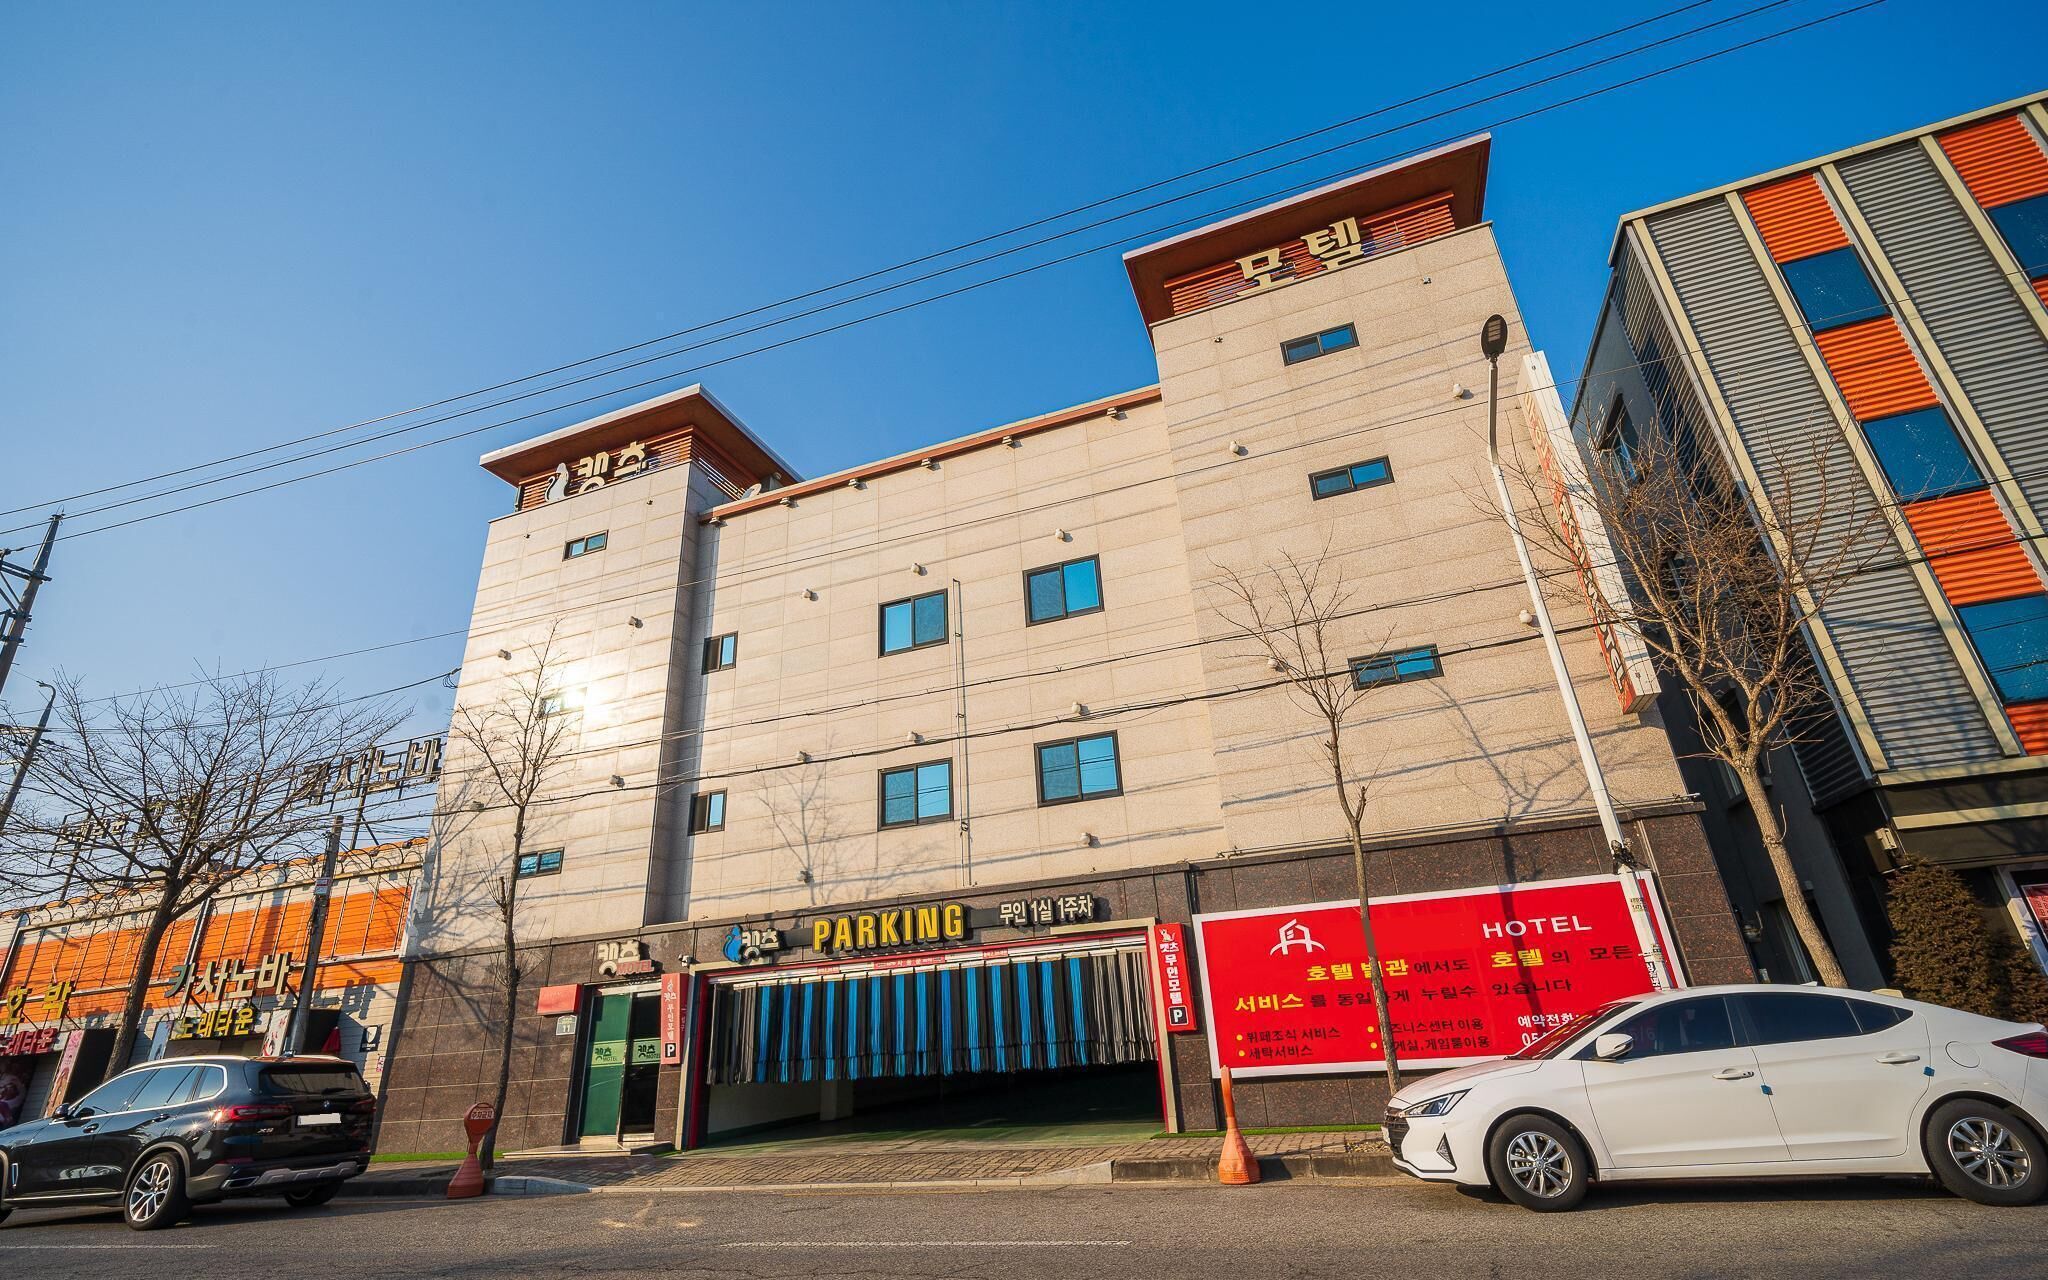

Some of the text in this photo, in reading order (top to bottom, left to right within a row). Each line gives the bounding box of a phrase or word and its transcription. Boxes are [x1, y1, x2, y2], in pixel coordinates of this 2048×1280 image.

[1235, 217, 1364, 297] 모텔
[1000, 895, 1093, 924] 무인 1실 1주차
[814, 903, 964, 951] PARKING
[1482, 916, 1592, 938] HOTEL
[616, 960, 654, 976] MOTEL
[1306, 963, 1354, 981] 호텔
[1414, 959, 1471, 975] 에서도
[1491, 948, 1545, 968] 호텔
[1551, 949, 1570, 964] 의
[1589, 945, 1633, 961] 모든
[164, 952, 291, 1004] 카사노바
[1165, 954, 1183, 1005] 무인모텔
[1234, 993, 1304, 1013] 서비스
[1310, 994, 1327, 1008] 를
[1338, 989, 1411, 1007] 동일게
[1492, 978, 1572, 996] 있습니다
[177, 1007, 254, 1039] 노래타운
[1173, 1009, 1183, 1023] P
[1378, 1018, 1484, 1034] 즈니스센터 이용
[1302, 1027, 1341, 1040] 서비스
[667, 1044, 675, 1057] P
[1249, 1045, 1313, 1060] 세탁서비스
